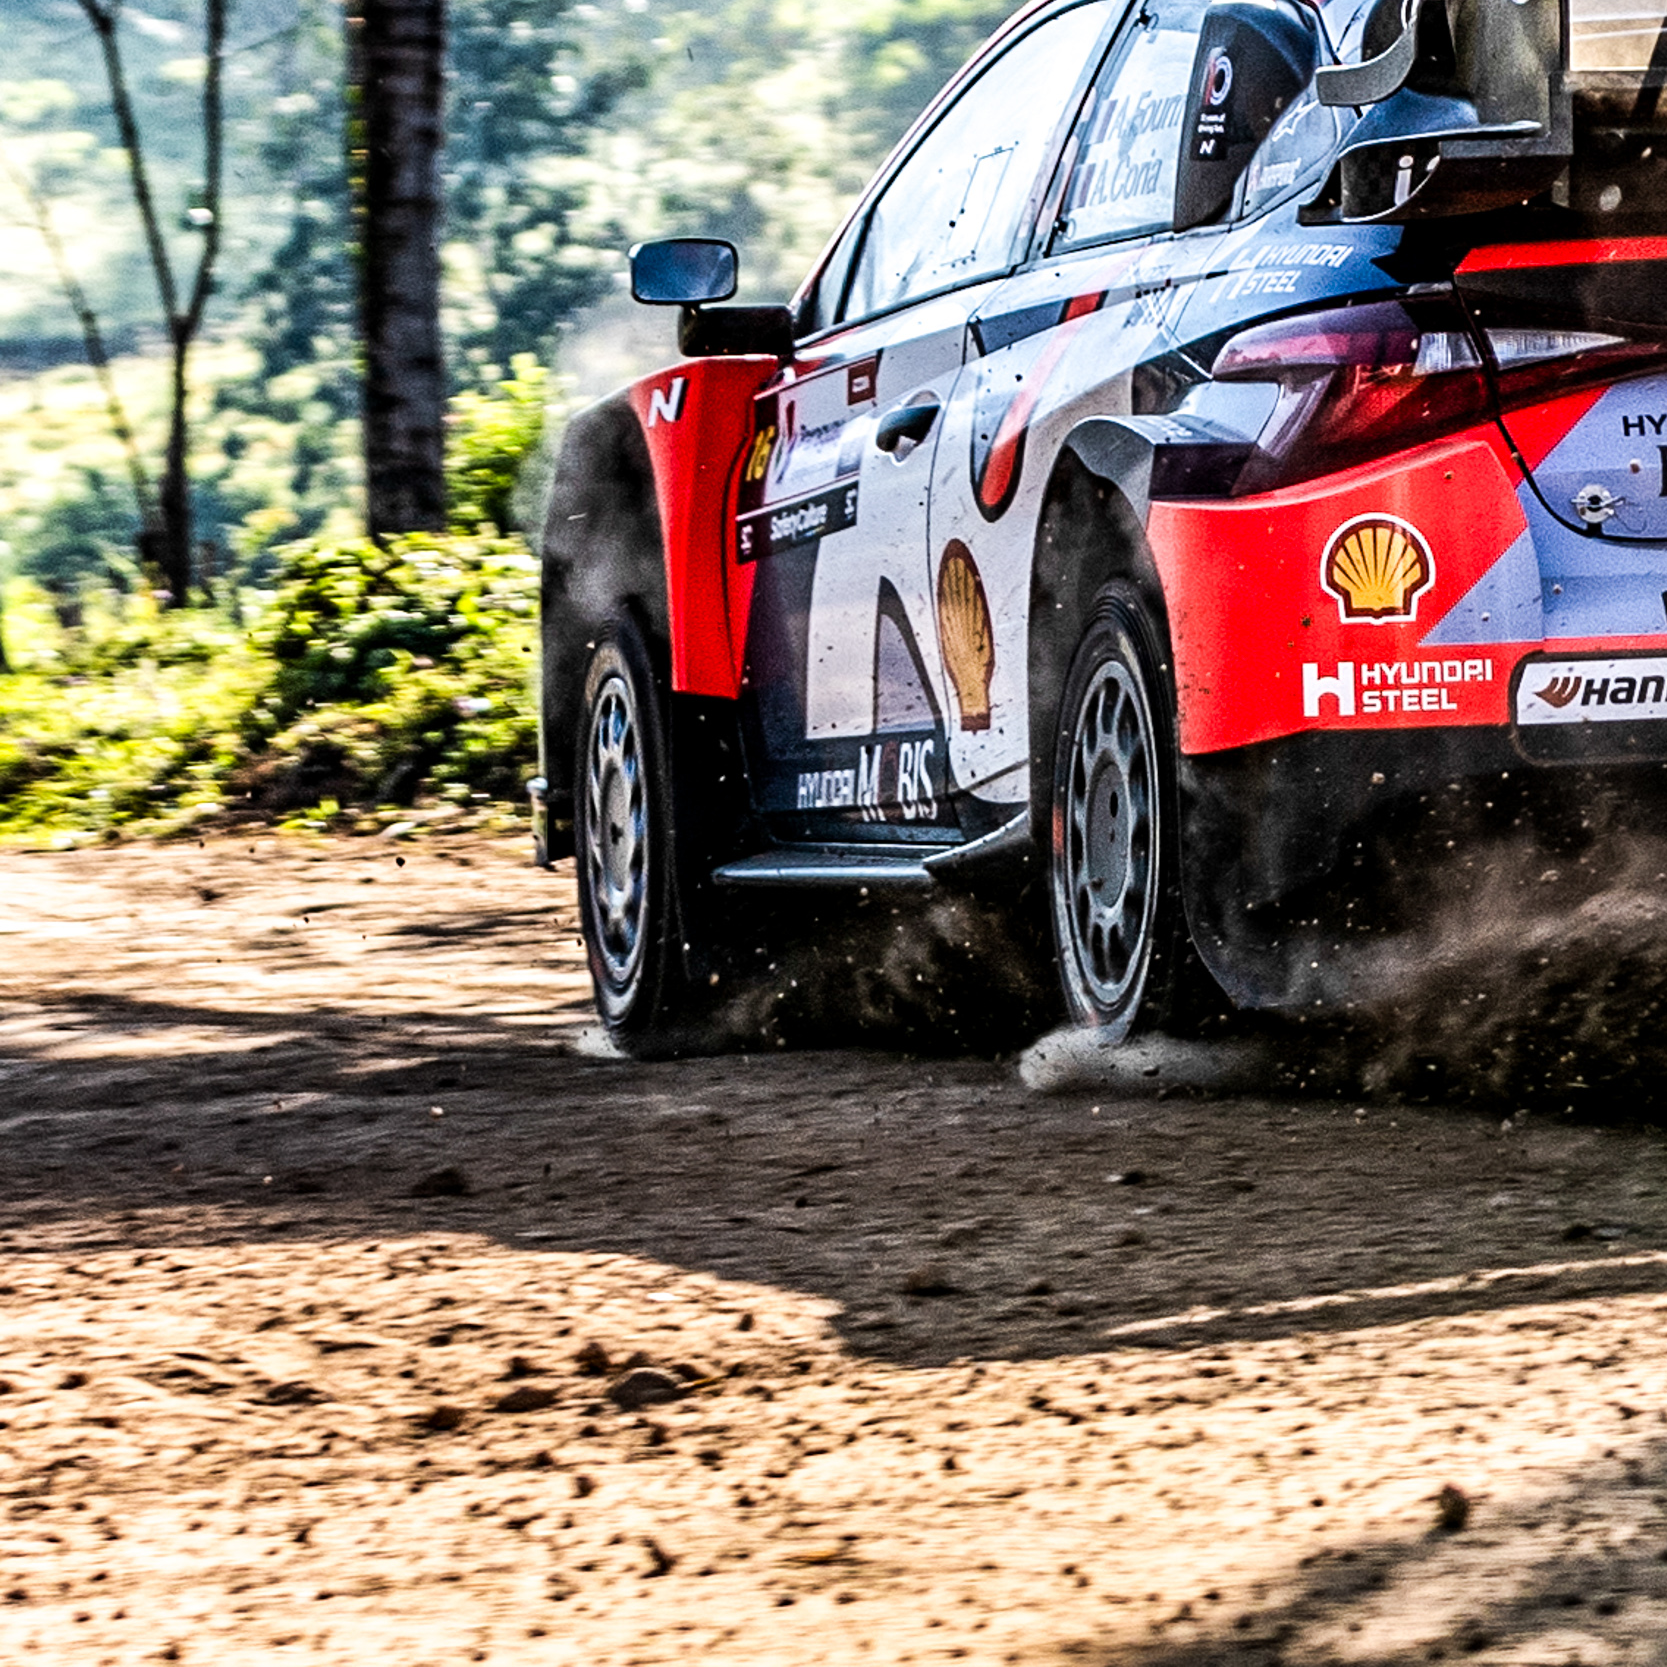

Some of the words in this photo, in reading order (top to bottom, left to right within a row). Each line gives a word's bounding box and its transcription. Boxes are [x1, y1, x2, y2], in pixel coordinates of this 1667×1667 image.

[1260, 244, 1354, 268] HYUNDAI
[1241, 270, 1302, 294] STEEL
[648, 376, 688, 429] N
[1360, 658, 1493, 686] HYUNDAI
[1362, 687, 1458, 713] STEEL
[857, 738, 938, 822] MOBIS
